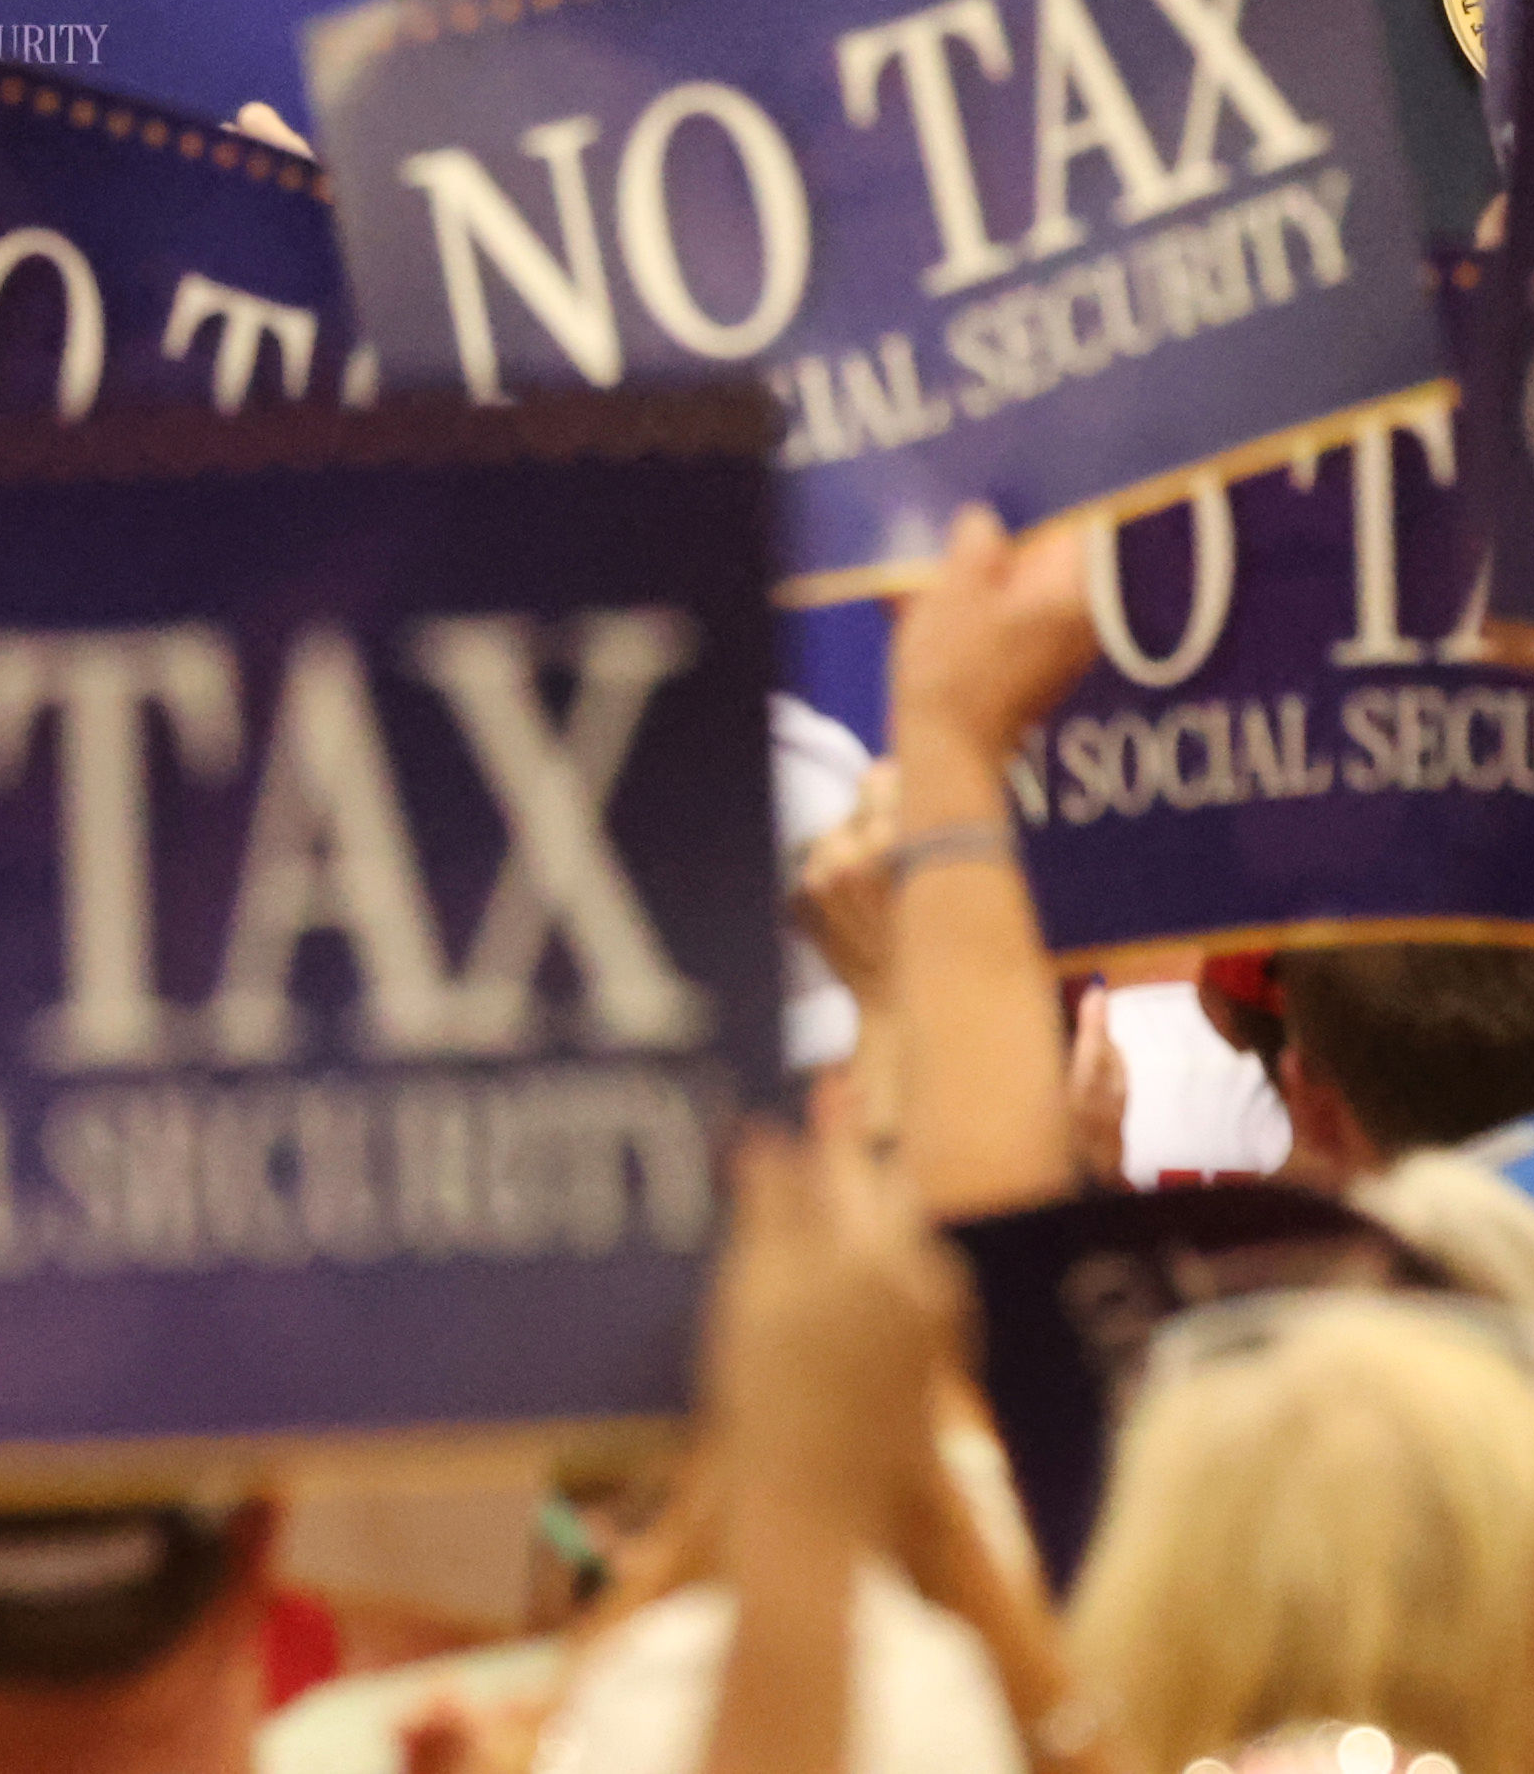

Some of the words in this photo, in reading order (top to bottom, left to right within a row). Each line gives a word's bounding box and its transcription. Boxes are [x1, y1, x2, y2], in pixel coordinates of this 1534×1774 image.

[398, 79, 811, 408] NO
[944, 169, 1352, 420] SECURITY
[1057, 692, 1334, 824] SOCIAL
